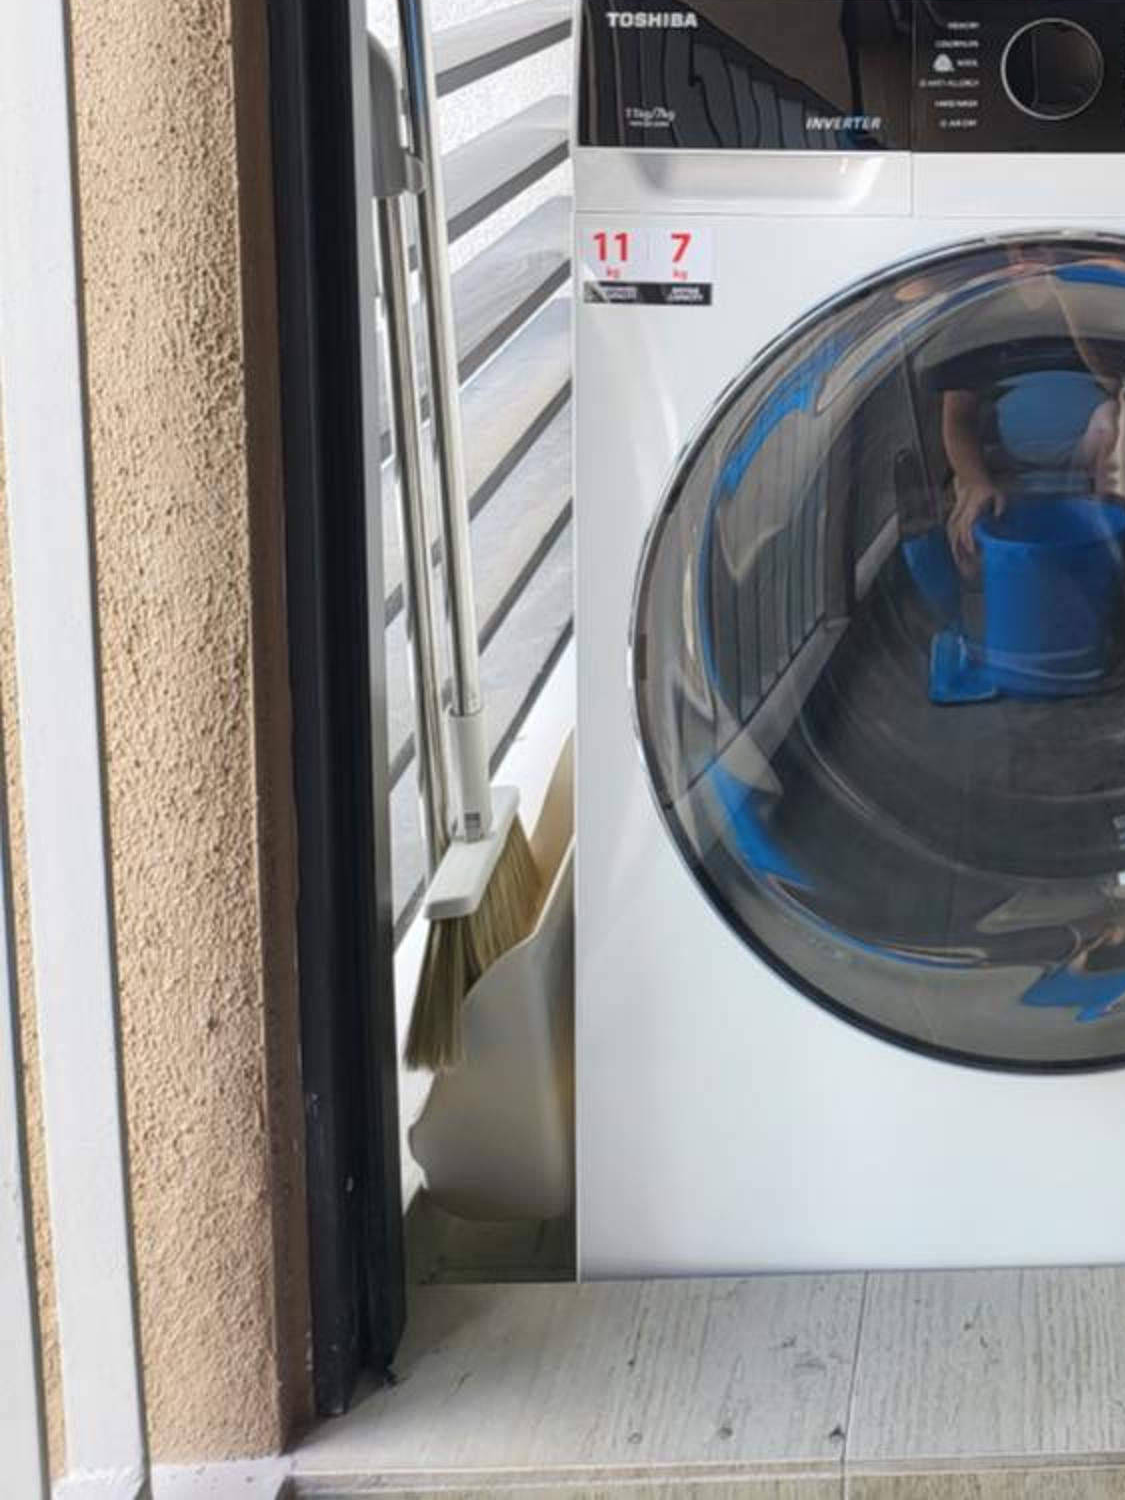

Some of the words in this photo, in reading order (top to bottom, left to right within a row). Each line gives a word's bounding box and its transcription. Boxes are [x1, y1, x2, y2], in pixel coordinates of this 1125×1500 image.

[607, 12, 698, 28] TOSHIBA
[805, 116, 882, 130] INVERTER
[593, 232, 628, 261] 11
[671, 232, 692, 263] 7
